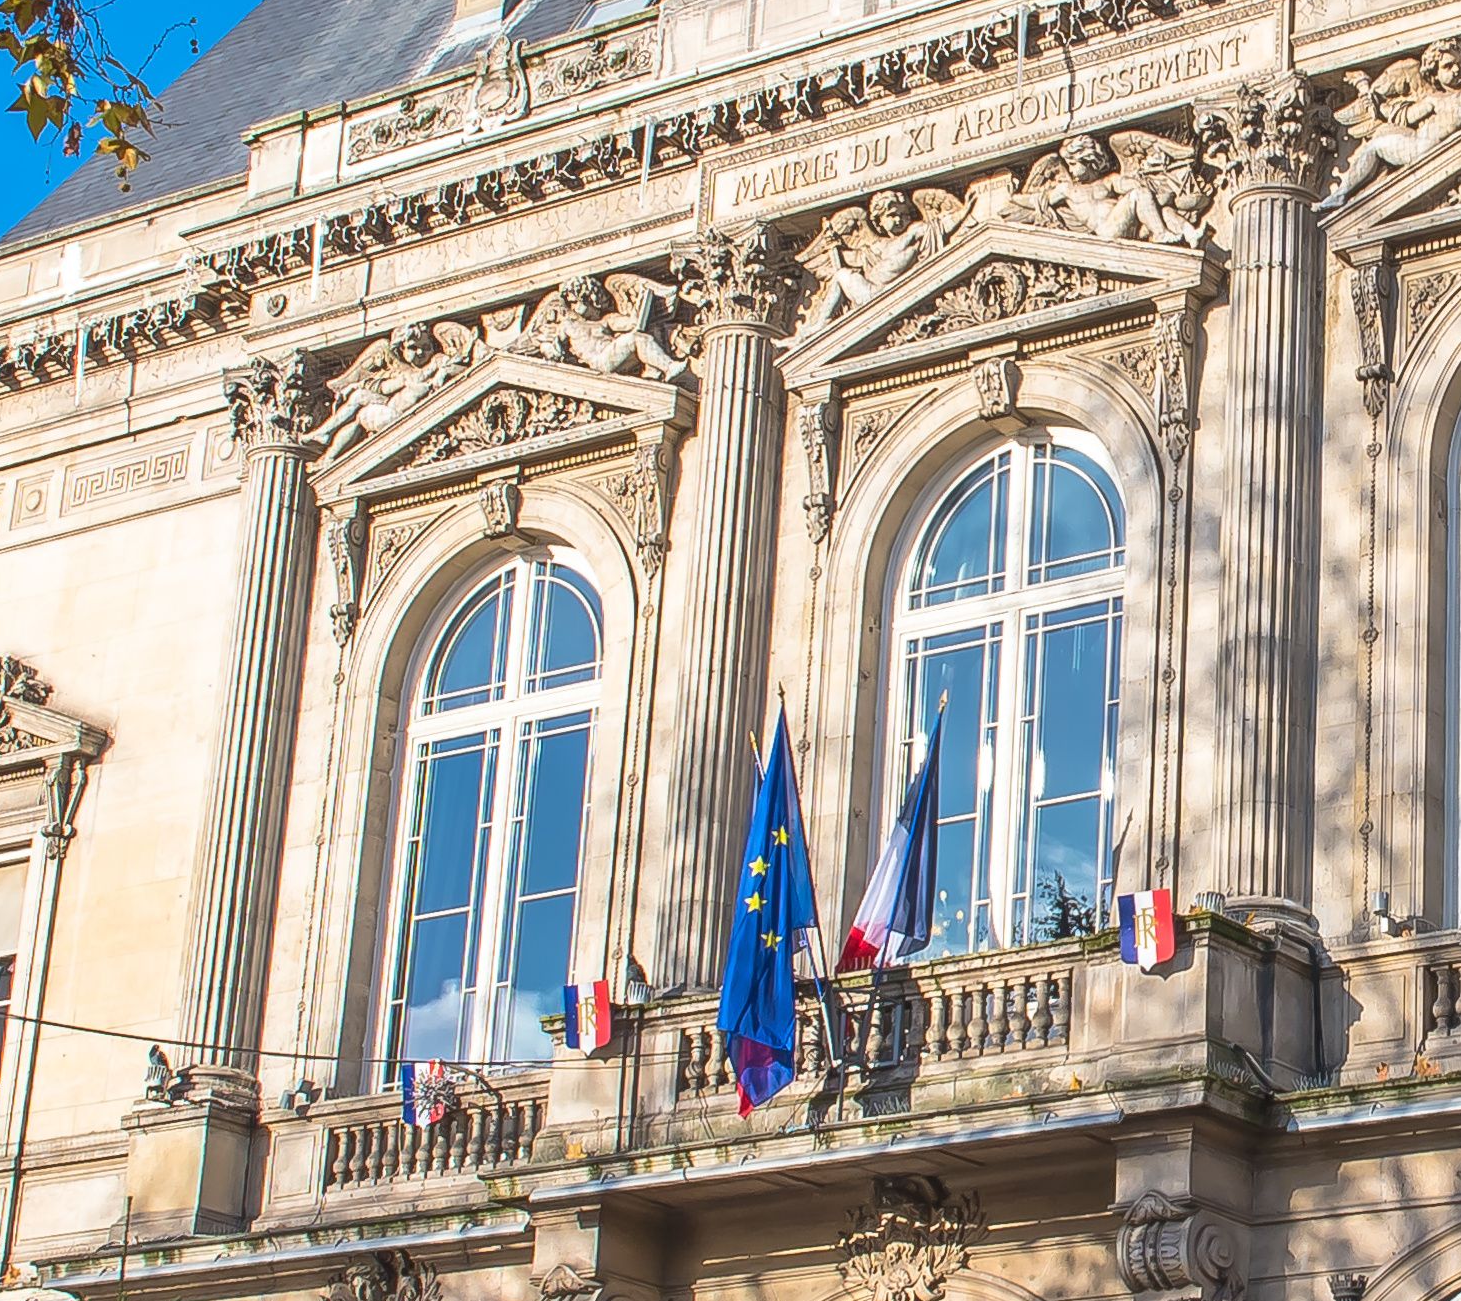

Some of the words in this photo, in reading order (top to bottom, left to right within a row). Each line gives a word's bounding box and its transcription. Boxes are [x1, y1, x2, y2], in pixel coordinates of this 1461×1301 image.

[732, 150, 839, 207] MAIRIE
[849, 134, 891, 175] DU
[903, 122, 937, 159] XI
[951, 35, 1248, 146] ARRONDISSEMENT
